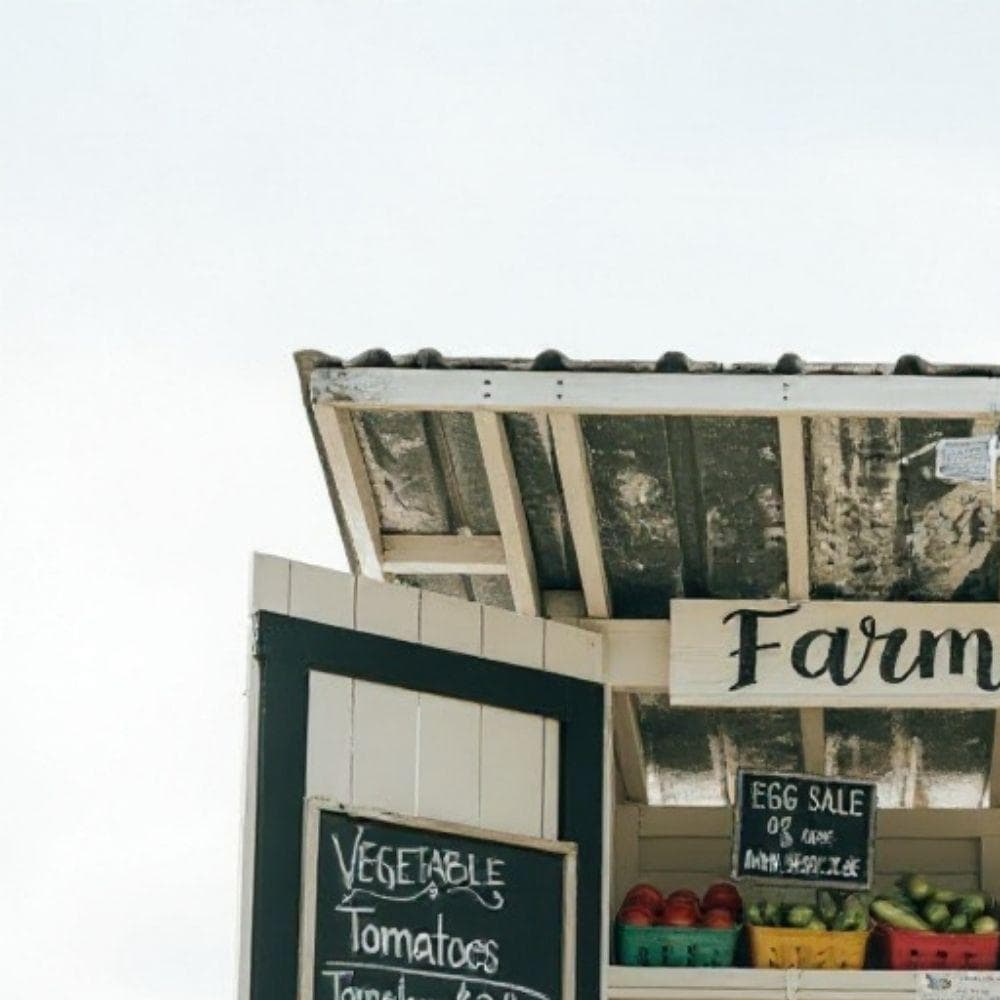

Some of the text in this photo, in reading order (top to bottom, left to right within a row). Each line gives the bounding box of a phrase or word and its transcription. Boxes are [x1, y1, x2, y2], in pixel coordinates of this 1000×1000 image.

[808, 785, 864, 816] SALE
[331, 825, 505, 890] VEGETABLE
[335, 904, 499, 974] Tomatoes
